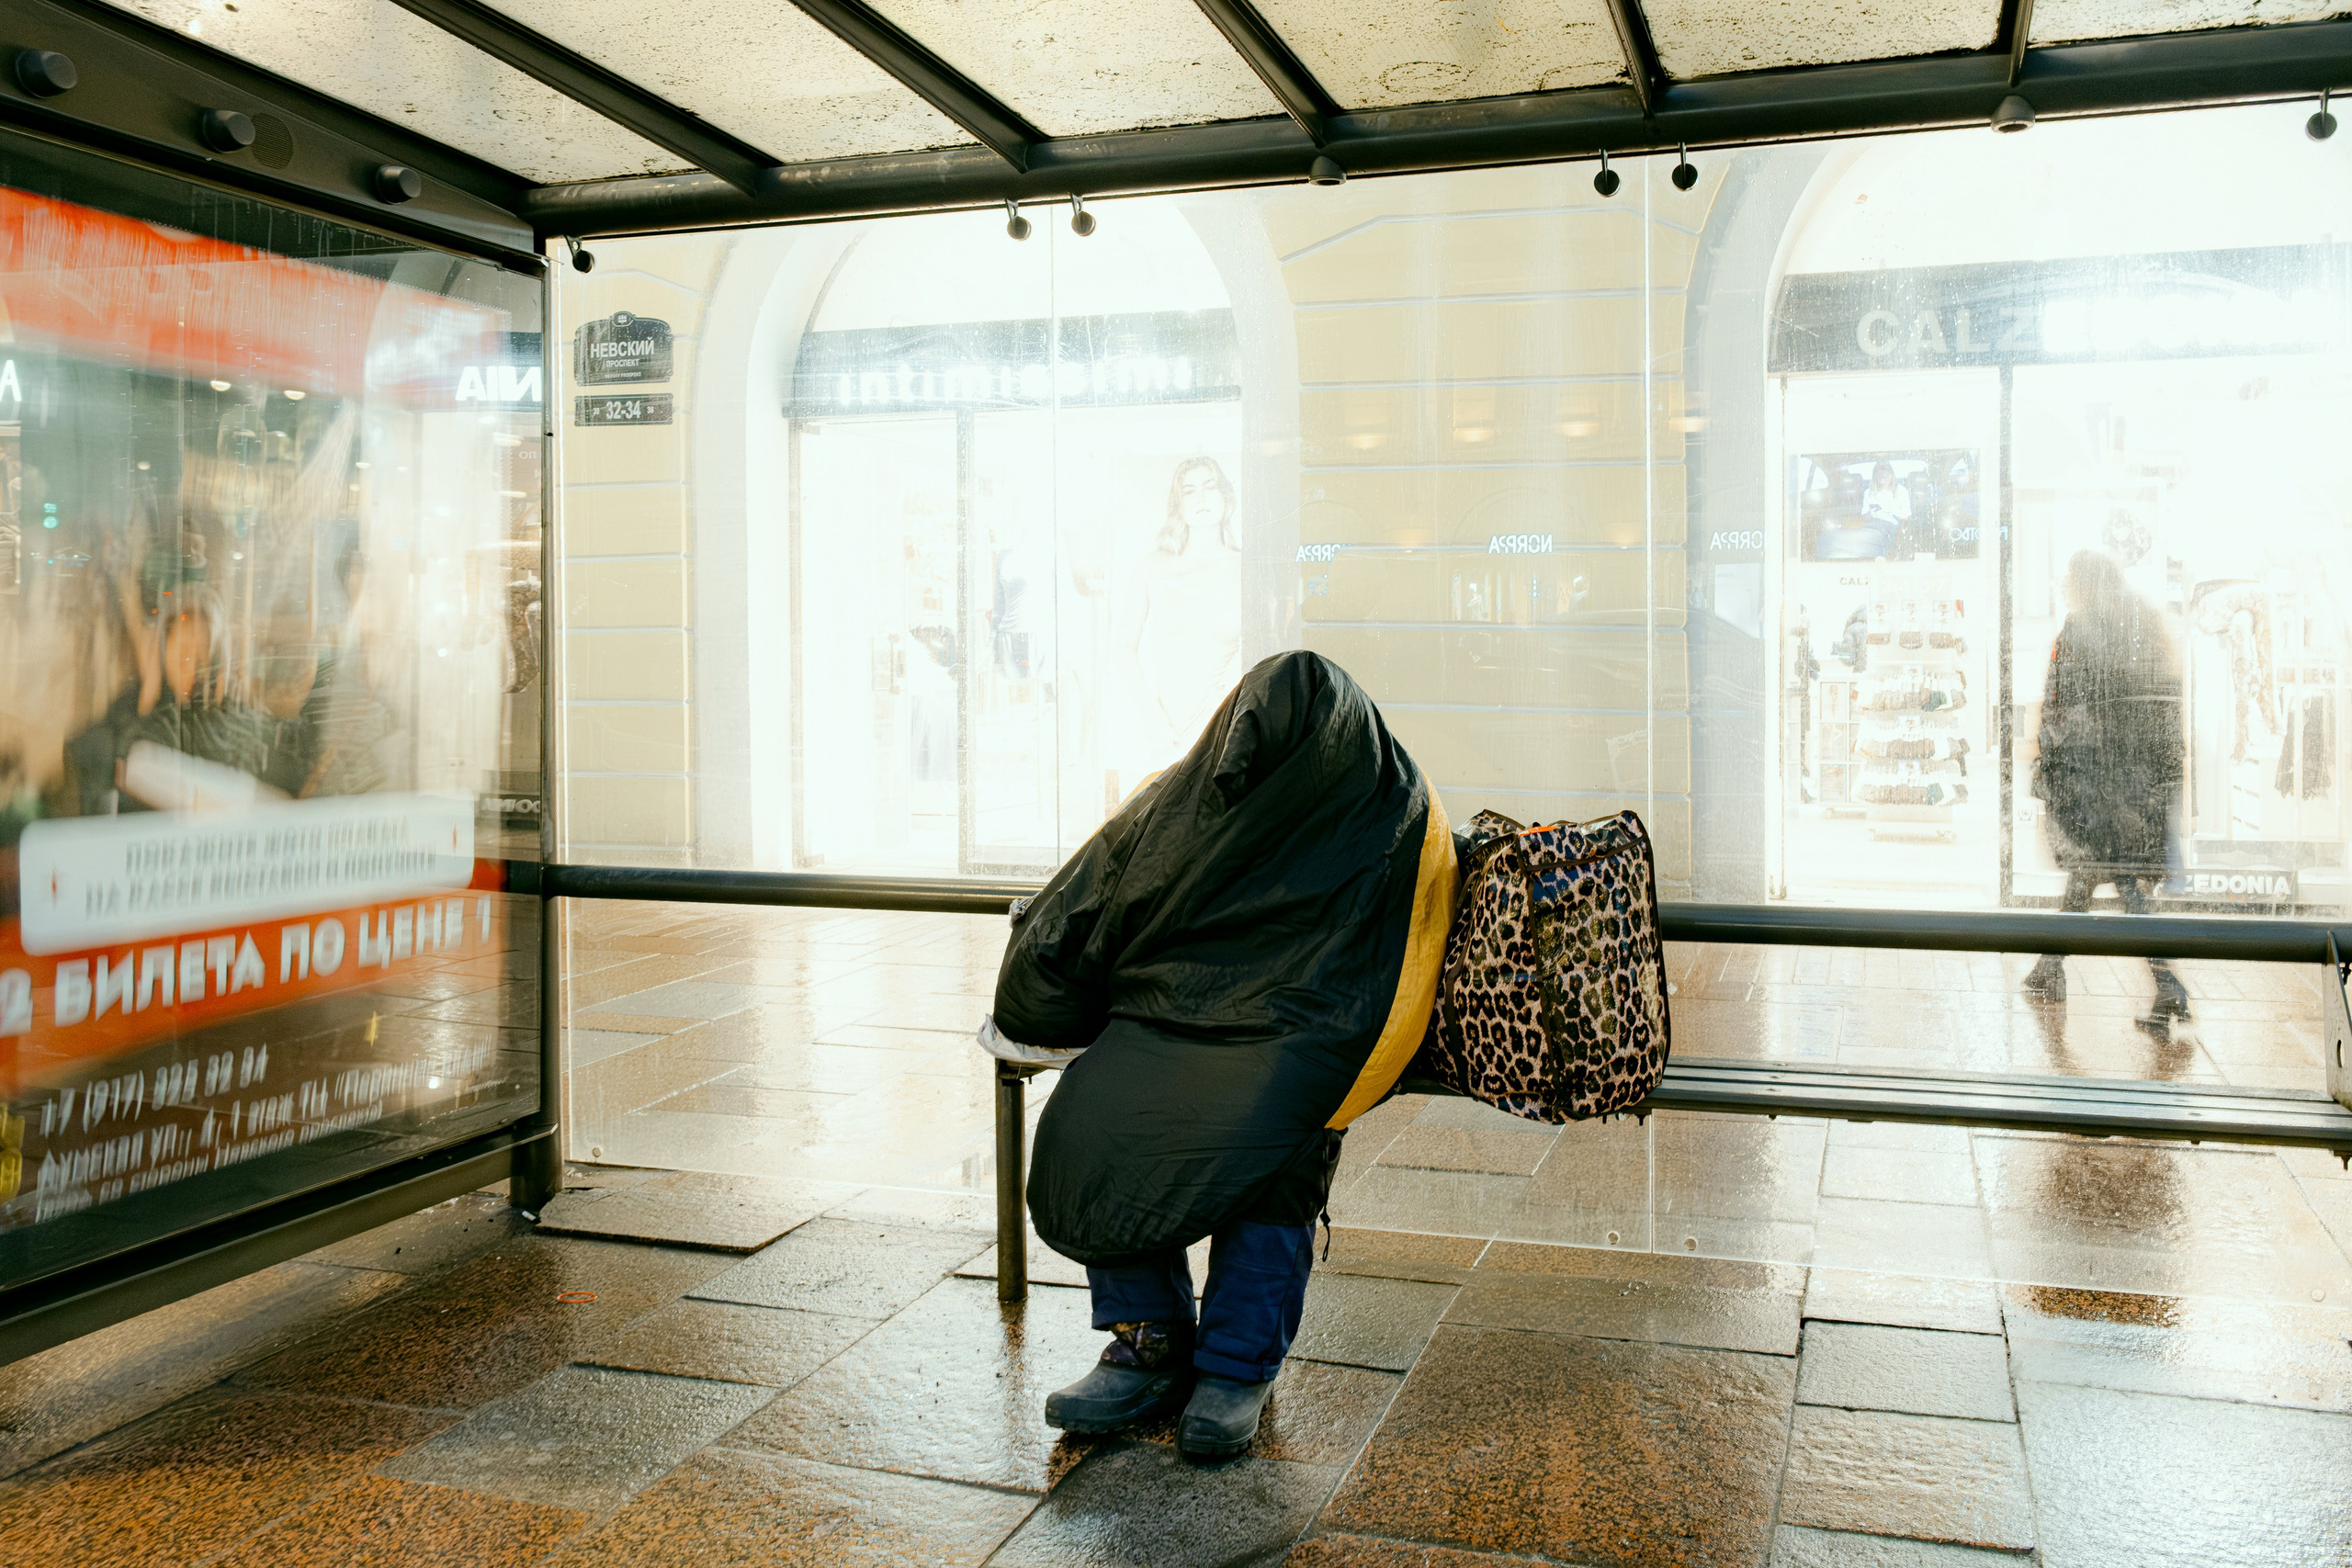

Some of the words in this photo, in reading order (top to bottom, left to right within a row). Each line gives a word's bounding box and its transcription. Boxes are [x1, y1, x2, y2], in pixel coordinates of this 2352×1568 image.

[590, 337, 655, 358] НЕВСКИЙ
[605, 358, 639, 368] ПРОСПЕКТ
[605, 400, 641, 420] 32-34
[54, 930, 266, 1028] БИЛЕТА
[279, 917, 346, 983] ПО
[358, 897, 465, 970] ЦЕНЕ
